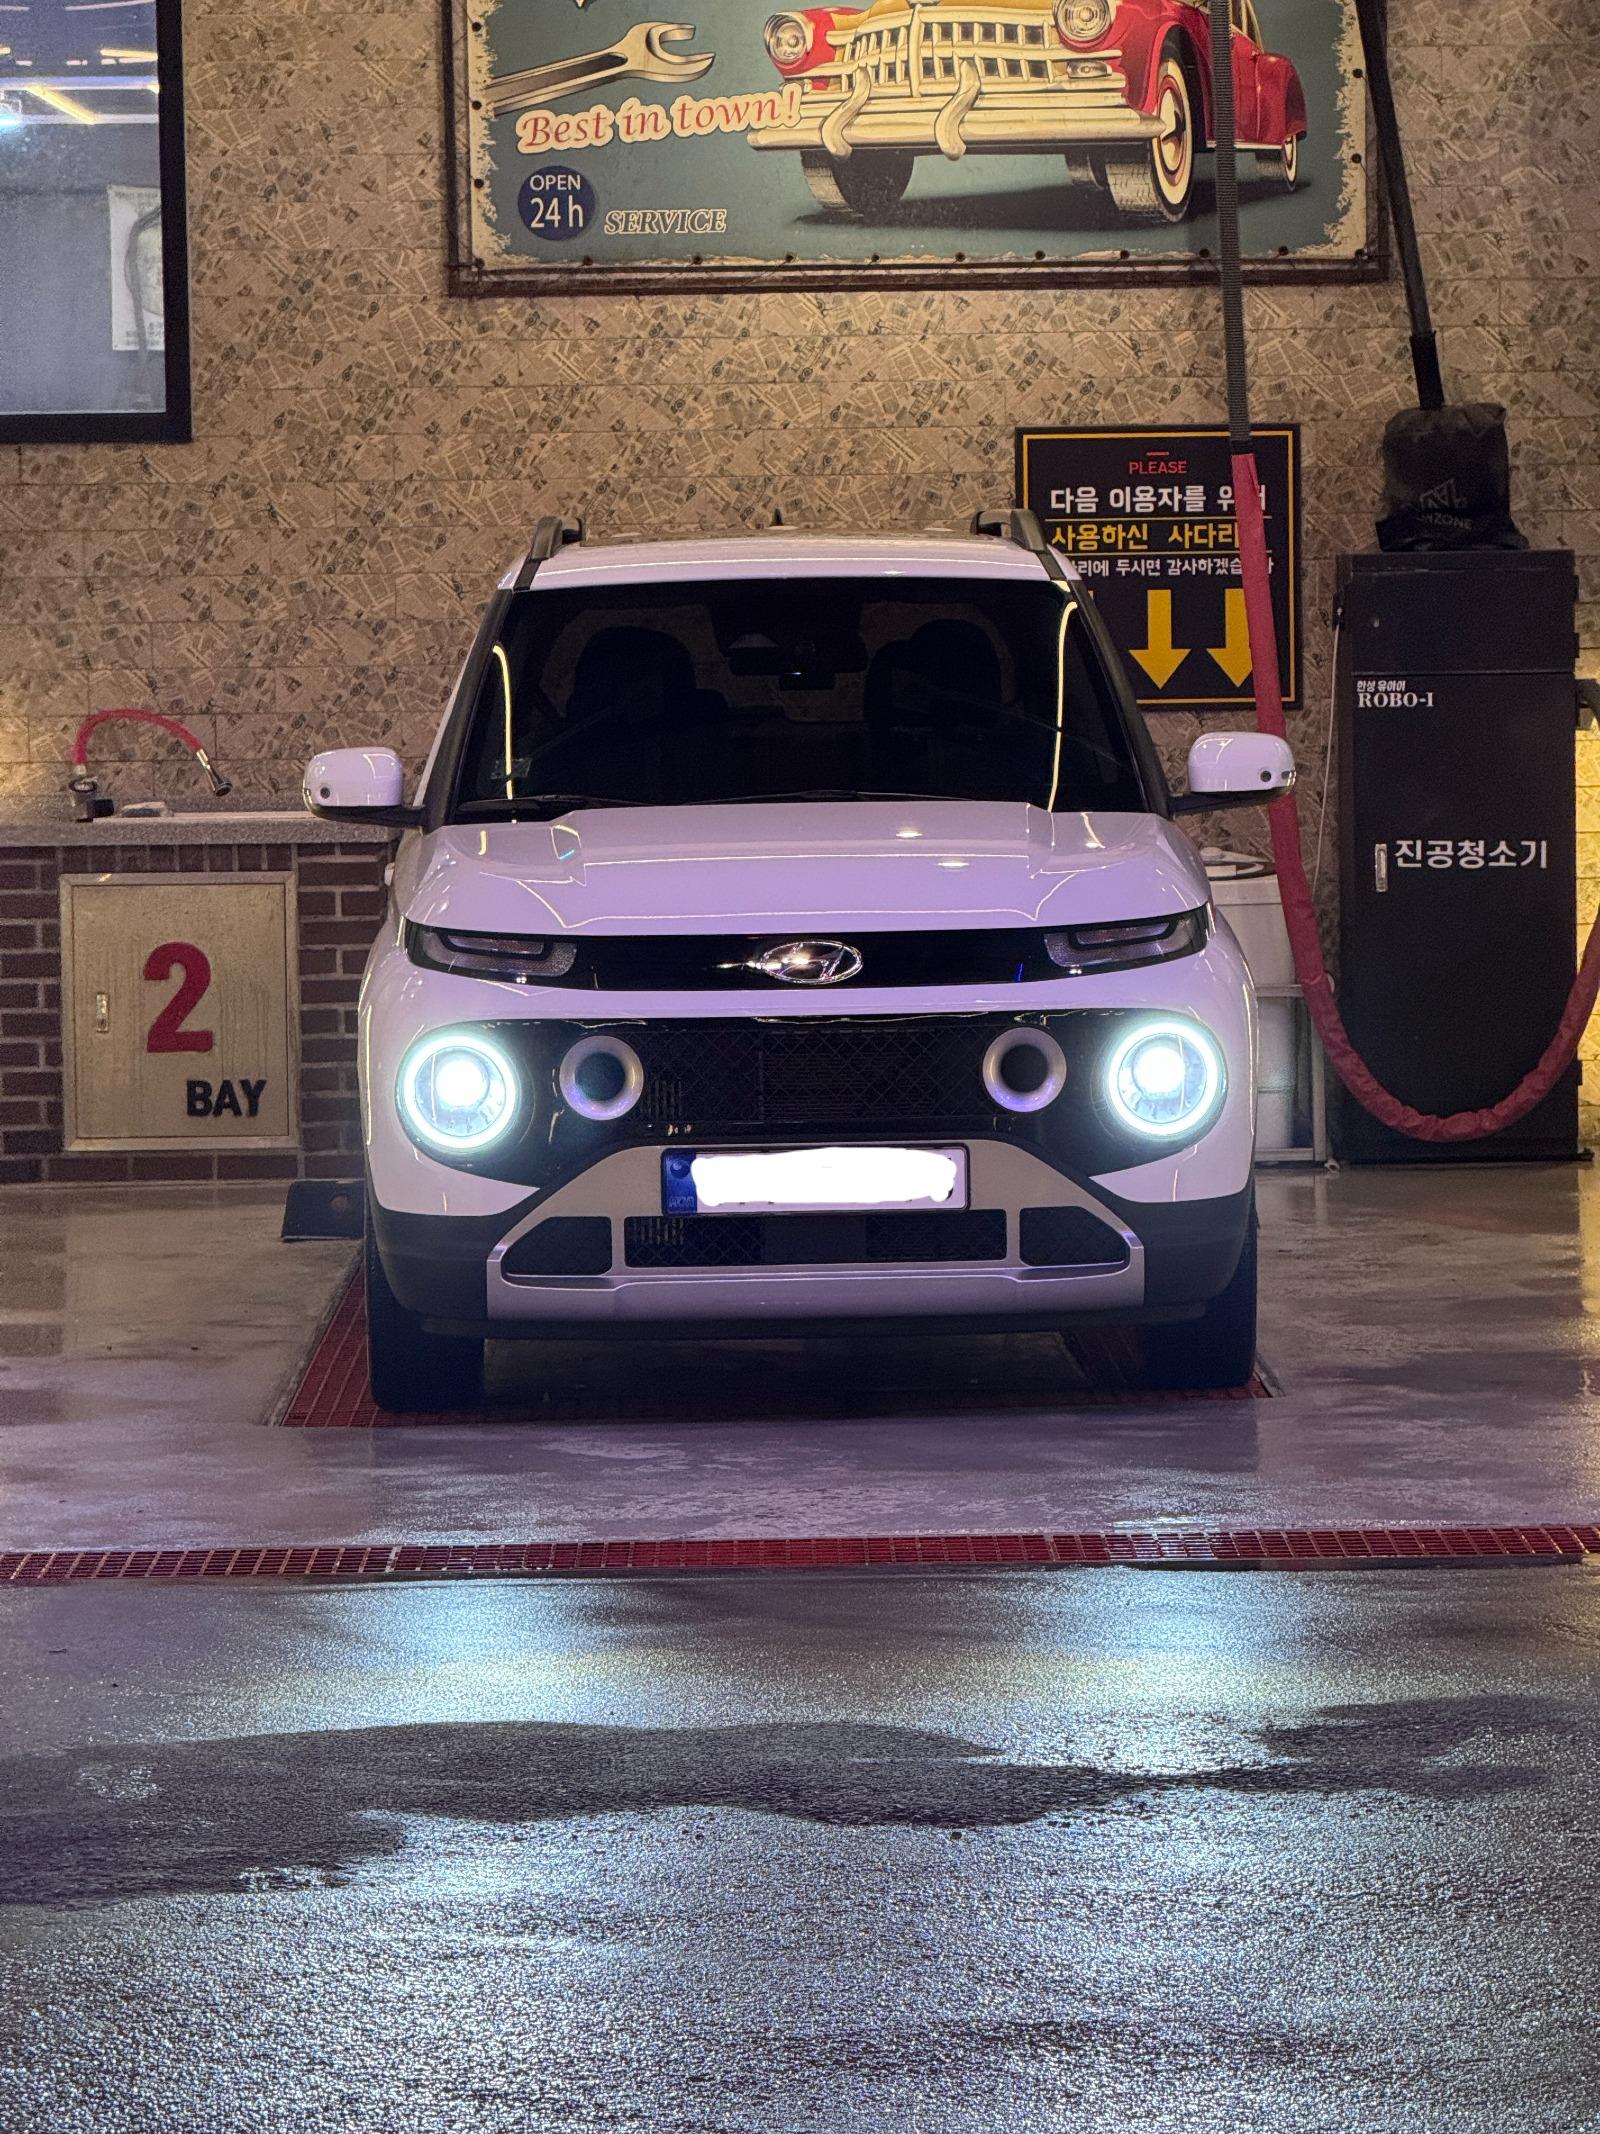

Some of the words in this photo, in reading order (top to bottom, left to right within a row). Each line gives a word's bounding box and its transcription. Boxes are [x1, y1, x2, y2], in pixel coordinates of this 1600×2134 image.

[523, 110, 607, 148] Best
[623, 103, 664, 136] in
[676, 90, 796, 131] town!
[529, 174, 581, 191] OPEN
[604, 208, 728, 235] SERVICE
[1128, 460, 1187, 475] PLEASE
[1050, 486, 1099, 514] 다음
[1109, 485, 1207, 513] 이용자를
[1051, 524, 1149, 551] 사용하신
[1115, 558, 1161, 576] 두시면
[1394, 839, 1547, 869] 진공청소기
[143, 941, 214, 1053] 2
[186, 1078, 267, 1118] BAY
